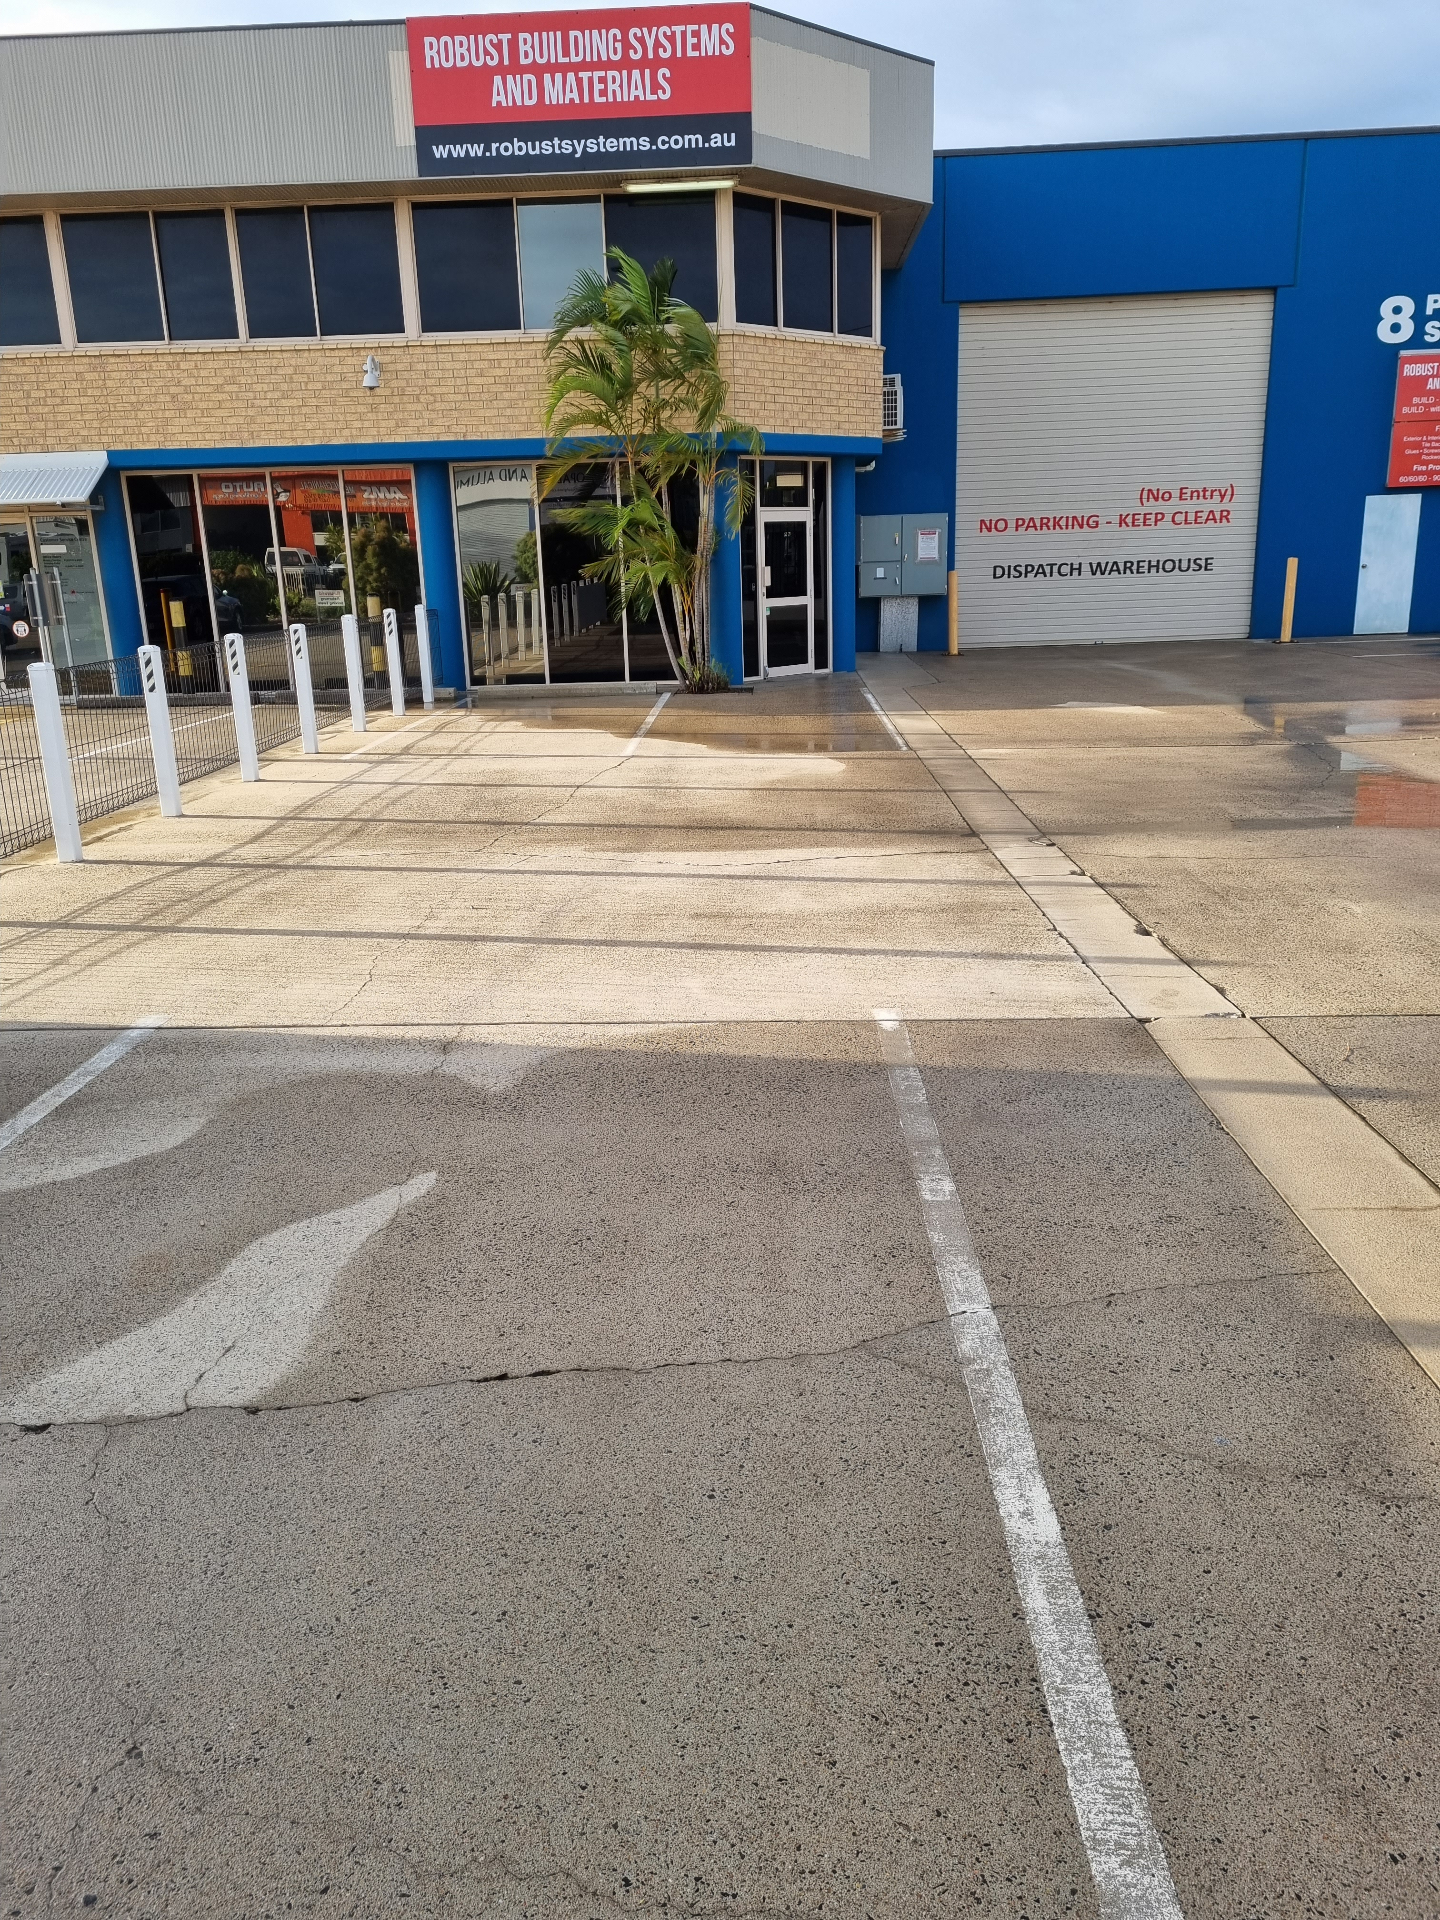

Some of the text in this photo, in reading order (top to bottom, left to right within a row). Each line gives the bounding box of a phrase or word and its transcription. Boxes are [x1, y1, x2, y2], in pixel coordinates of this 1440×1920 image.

[423, 23, 735, 68] ROBUST BUILDING SYSTEMS
[491, 68, 671, 107] AND MATERIALS
[432, 130, 737, 159] www.robustsystems.com.au
[1377, 295, 1416, 343] 8
[1403, 363, 1440, 377] ROBUST
[1402, 405, 1424, 414] BUILD
[1412, 396, 1434, 404] BUILD
[1139, 483, 1235, 506] (No Entry)
[978, 518, 1008, 533] NO
[1014, 514, 1100, 532] PARKING
[1118, 511, 1165, 528] KEEP
[1171, 509, 1231, 526] CLEAR
[992, 557, 1214, 580] DISPATCH WAREHOUSE
